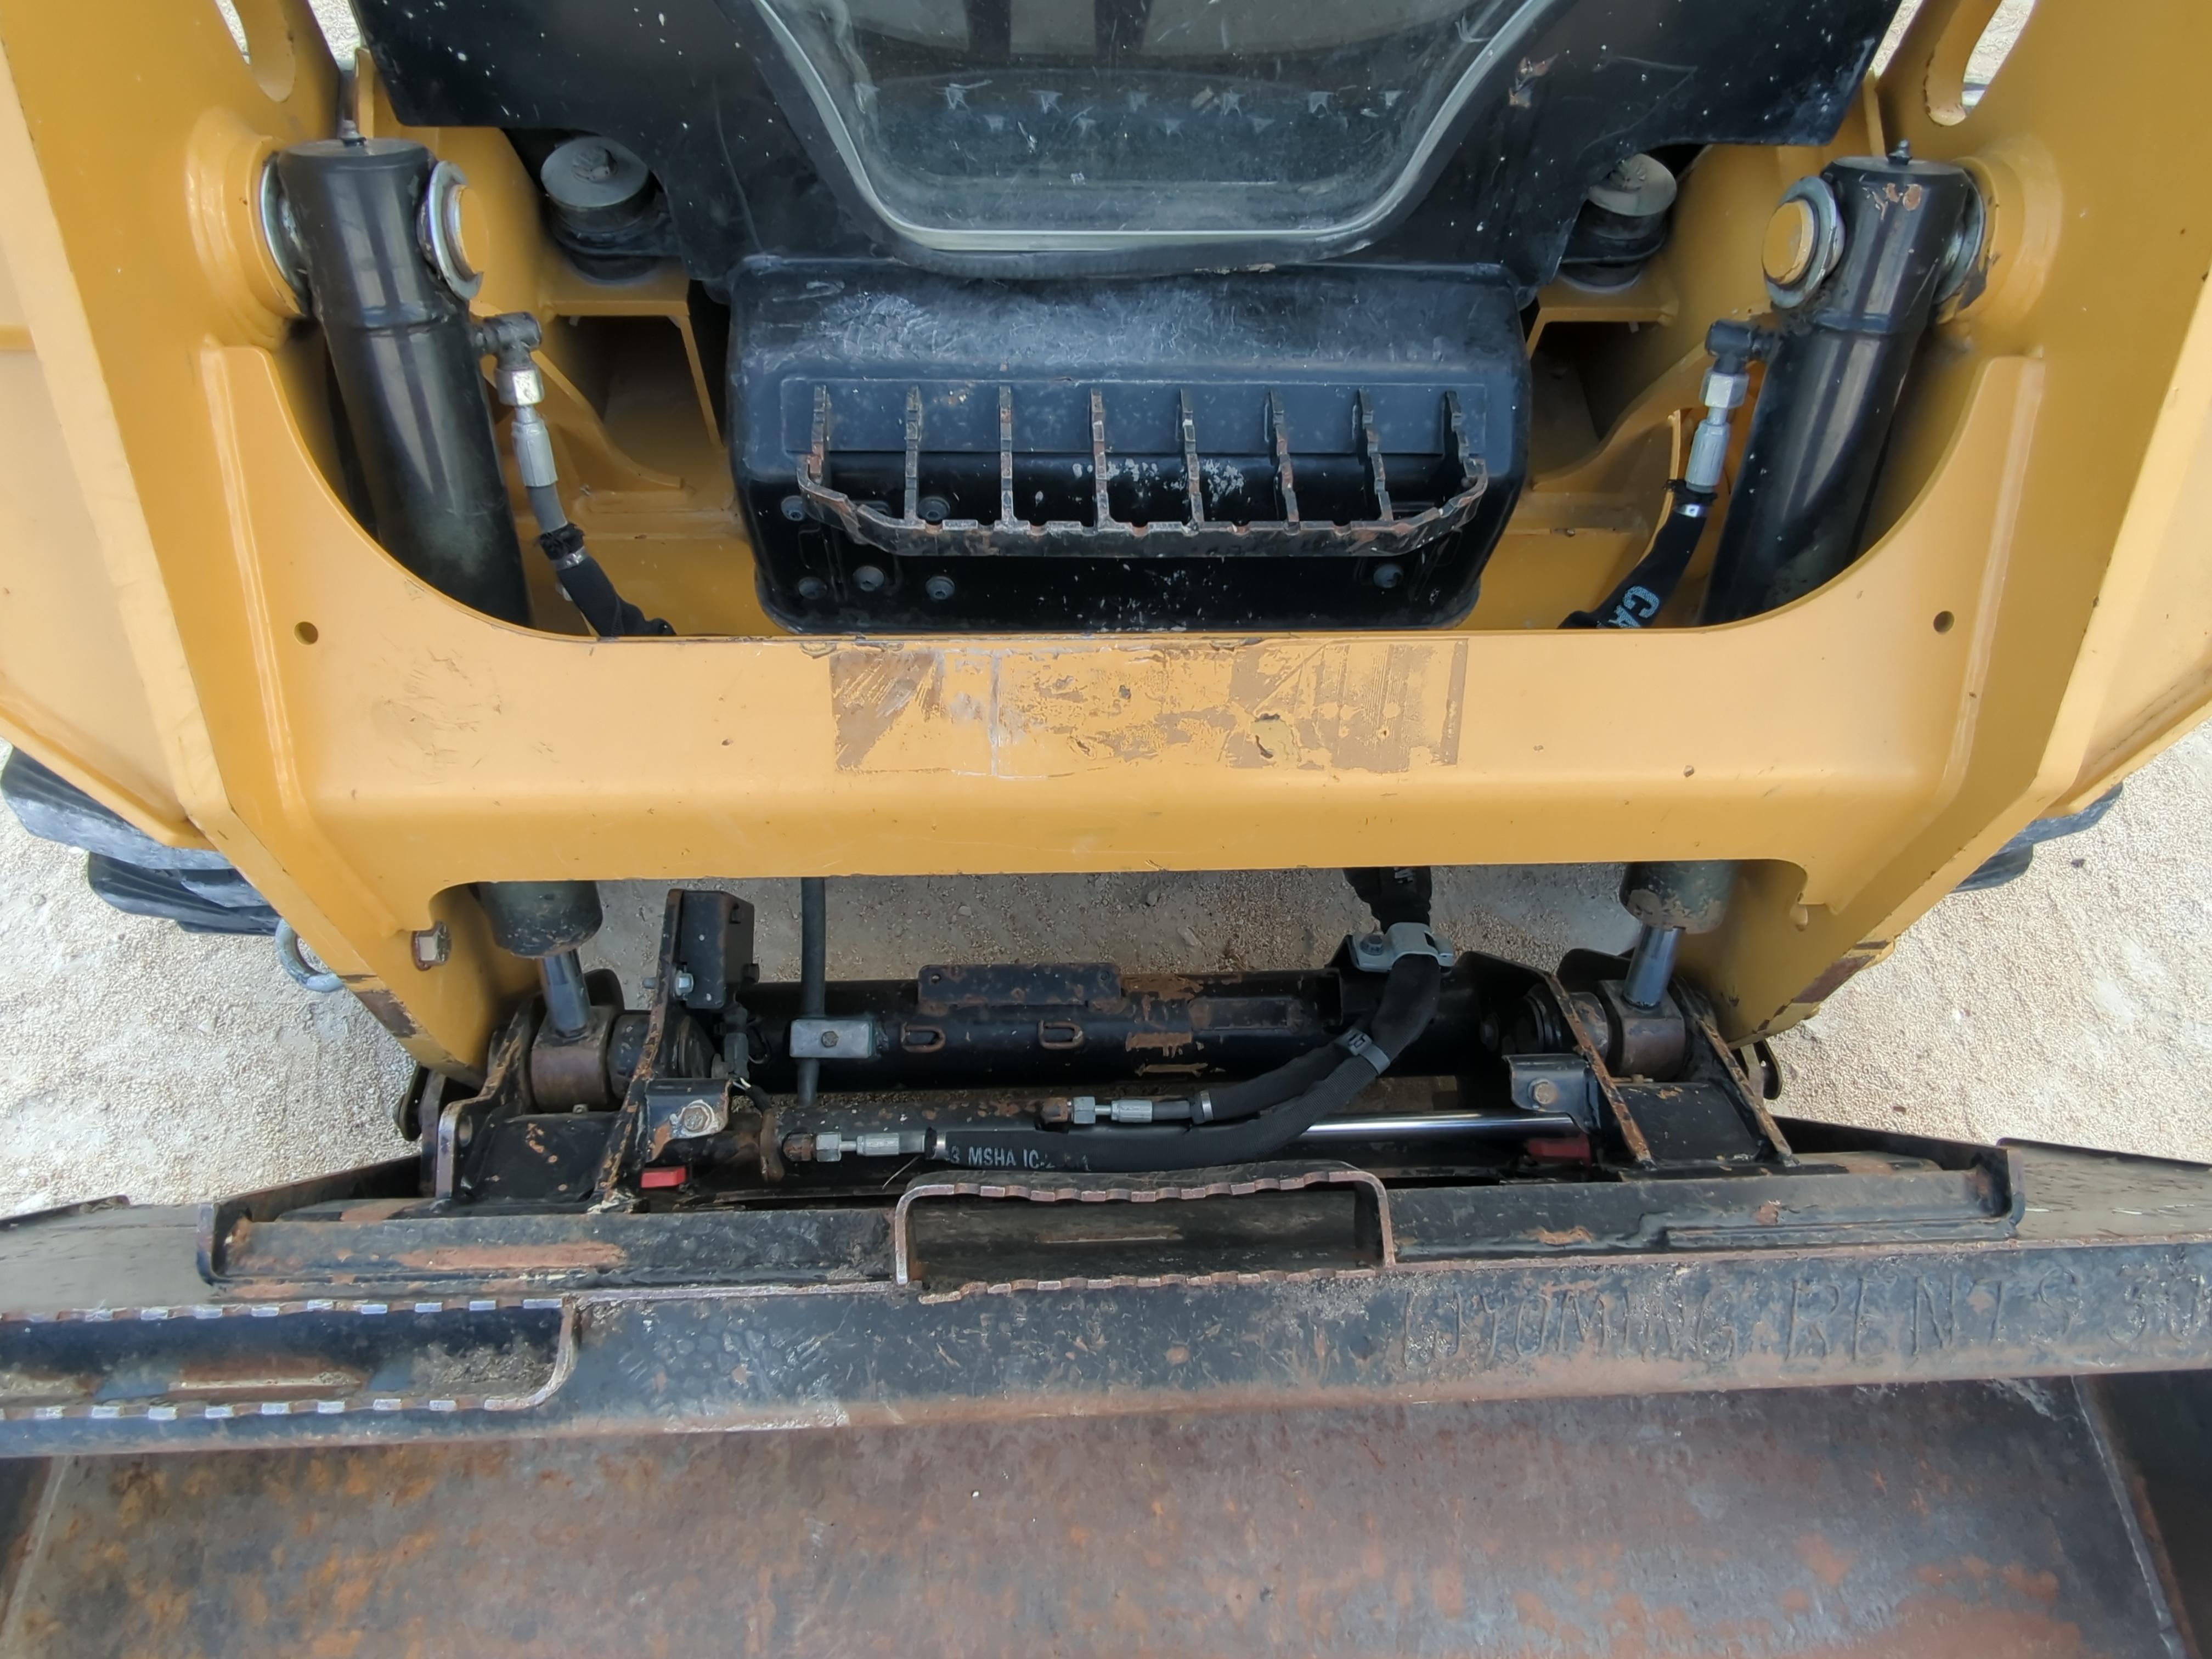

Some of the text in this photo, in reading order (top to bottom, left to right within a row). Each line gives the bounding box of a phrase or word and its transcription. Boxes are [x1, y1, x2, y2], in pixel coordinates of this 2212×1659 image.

[1598, 585, 1660, 629] CA
[968, 1146, 1017, 1167] MSHA
[1785, 1266, 2083, 1363] RENTS
